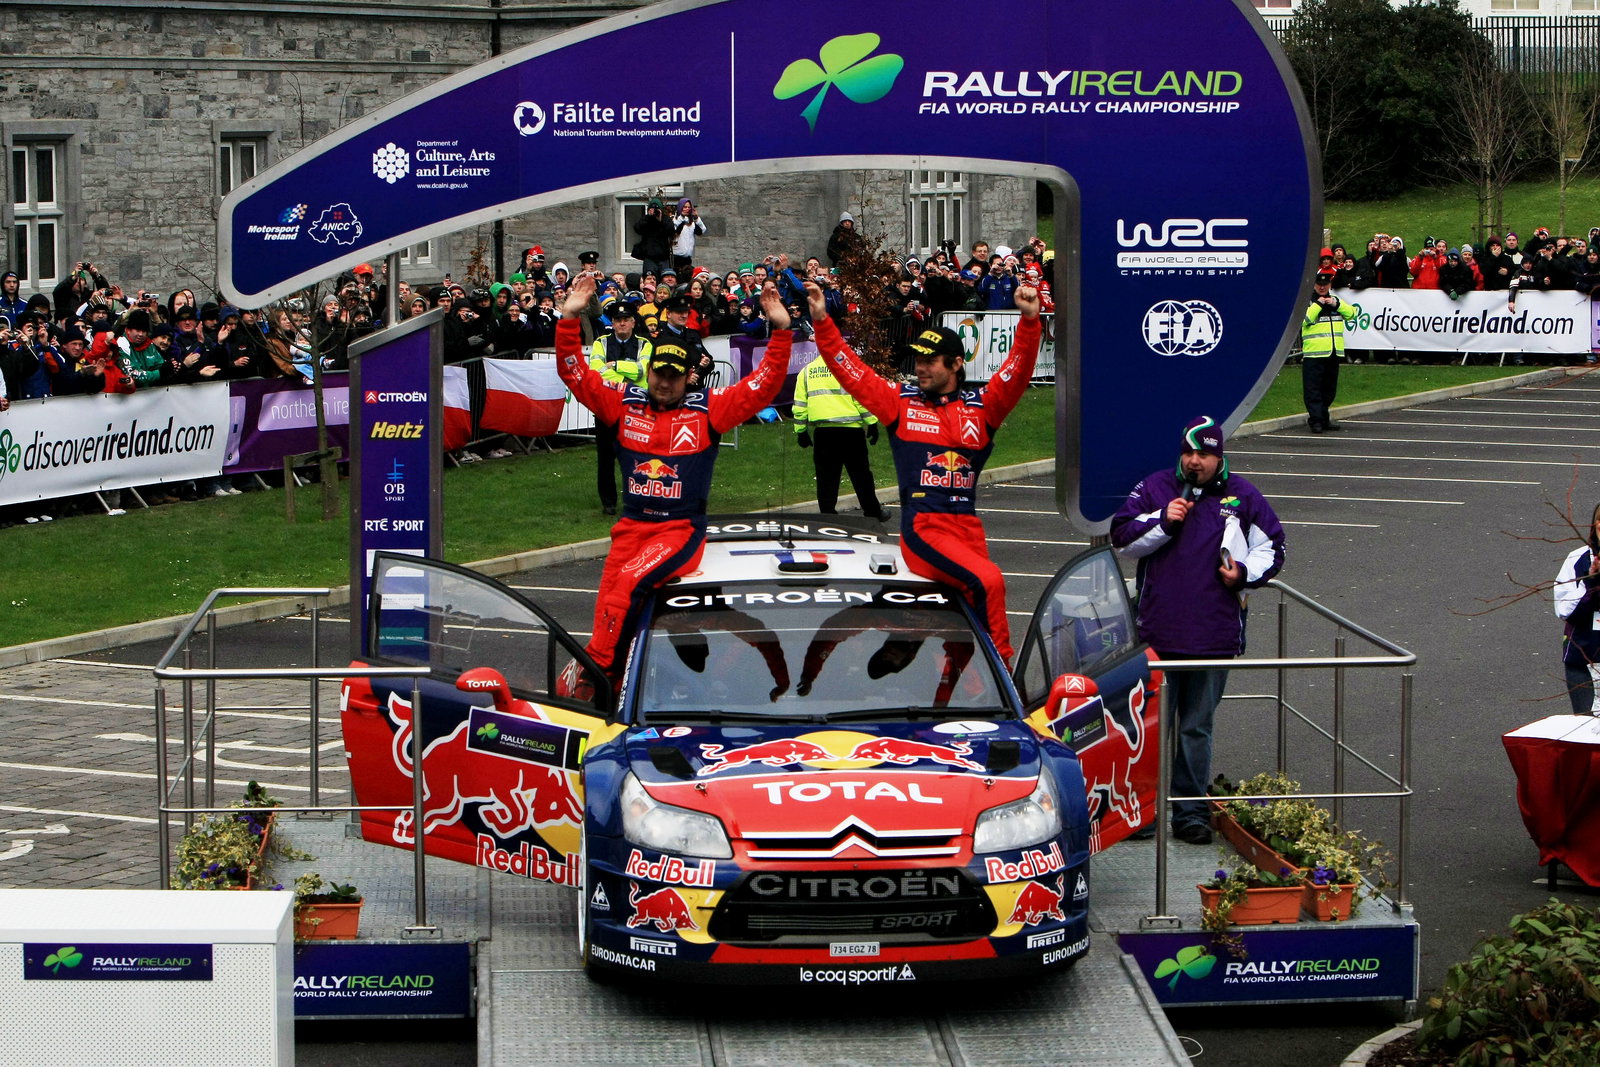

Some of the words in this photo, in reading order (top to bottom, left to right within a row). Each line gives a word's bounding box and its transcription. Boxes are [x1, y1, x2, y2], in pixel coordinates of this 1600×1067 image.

[923, 70, 1243, 97] RALLYIRELAND
[622, 101, 700, 123] Ireland
[919, 102, 950, 114] FIA
[956, 102, 1027, 114] WORLD
[1031, 102, 1091, 113] RALLY
[1095, 101, 1240, 113] CHAMPIONSHIP
[553, 129, 585, 137] National
[586, 129, 615, 137] Tourism
[616, 129, 664, 139] Development
[665, 129, 700, 139] Authority
[417, 140, 450, 148] Department
[415, 149, 466, 163] Culture,
[468, 148, 496, 161] Arts
[415, 164, 440, 177] and
[442, 164, 490, 177] Leisure
[247, 225, 300, 235] Motorsport
[321, 222, 350, 231] ANICC
[1117, 218, 1248, 247] WRC
[264, 232, 298, 241] Ireland
[1373, 306, 1574, 335] discoverireland.com
[378, 390, 427, 402] CITROËN
[271, 397, 330, 420] northen
[917, 412, 940, 421] TOTAL
[370, 421, 425, 439] Hertz
[632, 418, 652, 431] TOTAL
[907, 421, 940, 434] PIRELLI
[23, 416, 215, 472] discoverireland.com
[623, 429, 650, 443] PIRELLI
[628, 476, 653, 497] Red
[651, 480, 682, 499] Bull
[920, 469, 952, 488] Red
[952, 471, 975, 489] Bull
[392, 519, 424, 532] SPORT
[817, 527, 882, 544] C4
[666, 588, 874, 608] CITROËN
[882, 592, 948, 605] C4
[466, 679, 500, 689] TOTAL
[752, 781, 943, 805] TOTAL
[476, 832, 530, 877] Red
[529, 842, 580, 888] Bull
[625, 848, 668, 882] Red
[663, 855, 717, 887] Bull
[984, 850, 1037, 884] Red
[1030, 841, 1066, 877] Bull
[750, 871, 960, 898] CITROËN
[880, 910, 958, 929] SPORT
[630, 935, 677, 956] PIRELLI
[1027, 928, 1066, 949] PIRELLI
[591, 943, 656, 971] EURODATACAR
[833, 945, 847, 954] 734
[849, 945, 865, 953] EGZ
[867, 945, 877, 953] 78
[93, 957, 192, 966] RALLYIRELAND
[1225, 958, 1380, 976] RALLYIRELAND
[293, 975, 434, 989] ALLYIRELAND
[800, 966, 812, 982] le
[815, 969, 846, 986] coq
[848, 966, 897, 986] sportif
[1223, 976, 1239, 984] FIA
[1307, 973, 1379, 981] CHAMPIONSHIP
